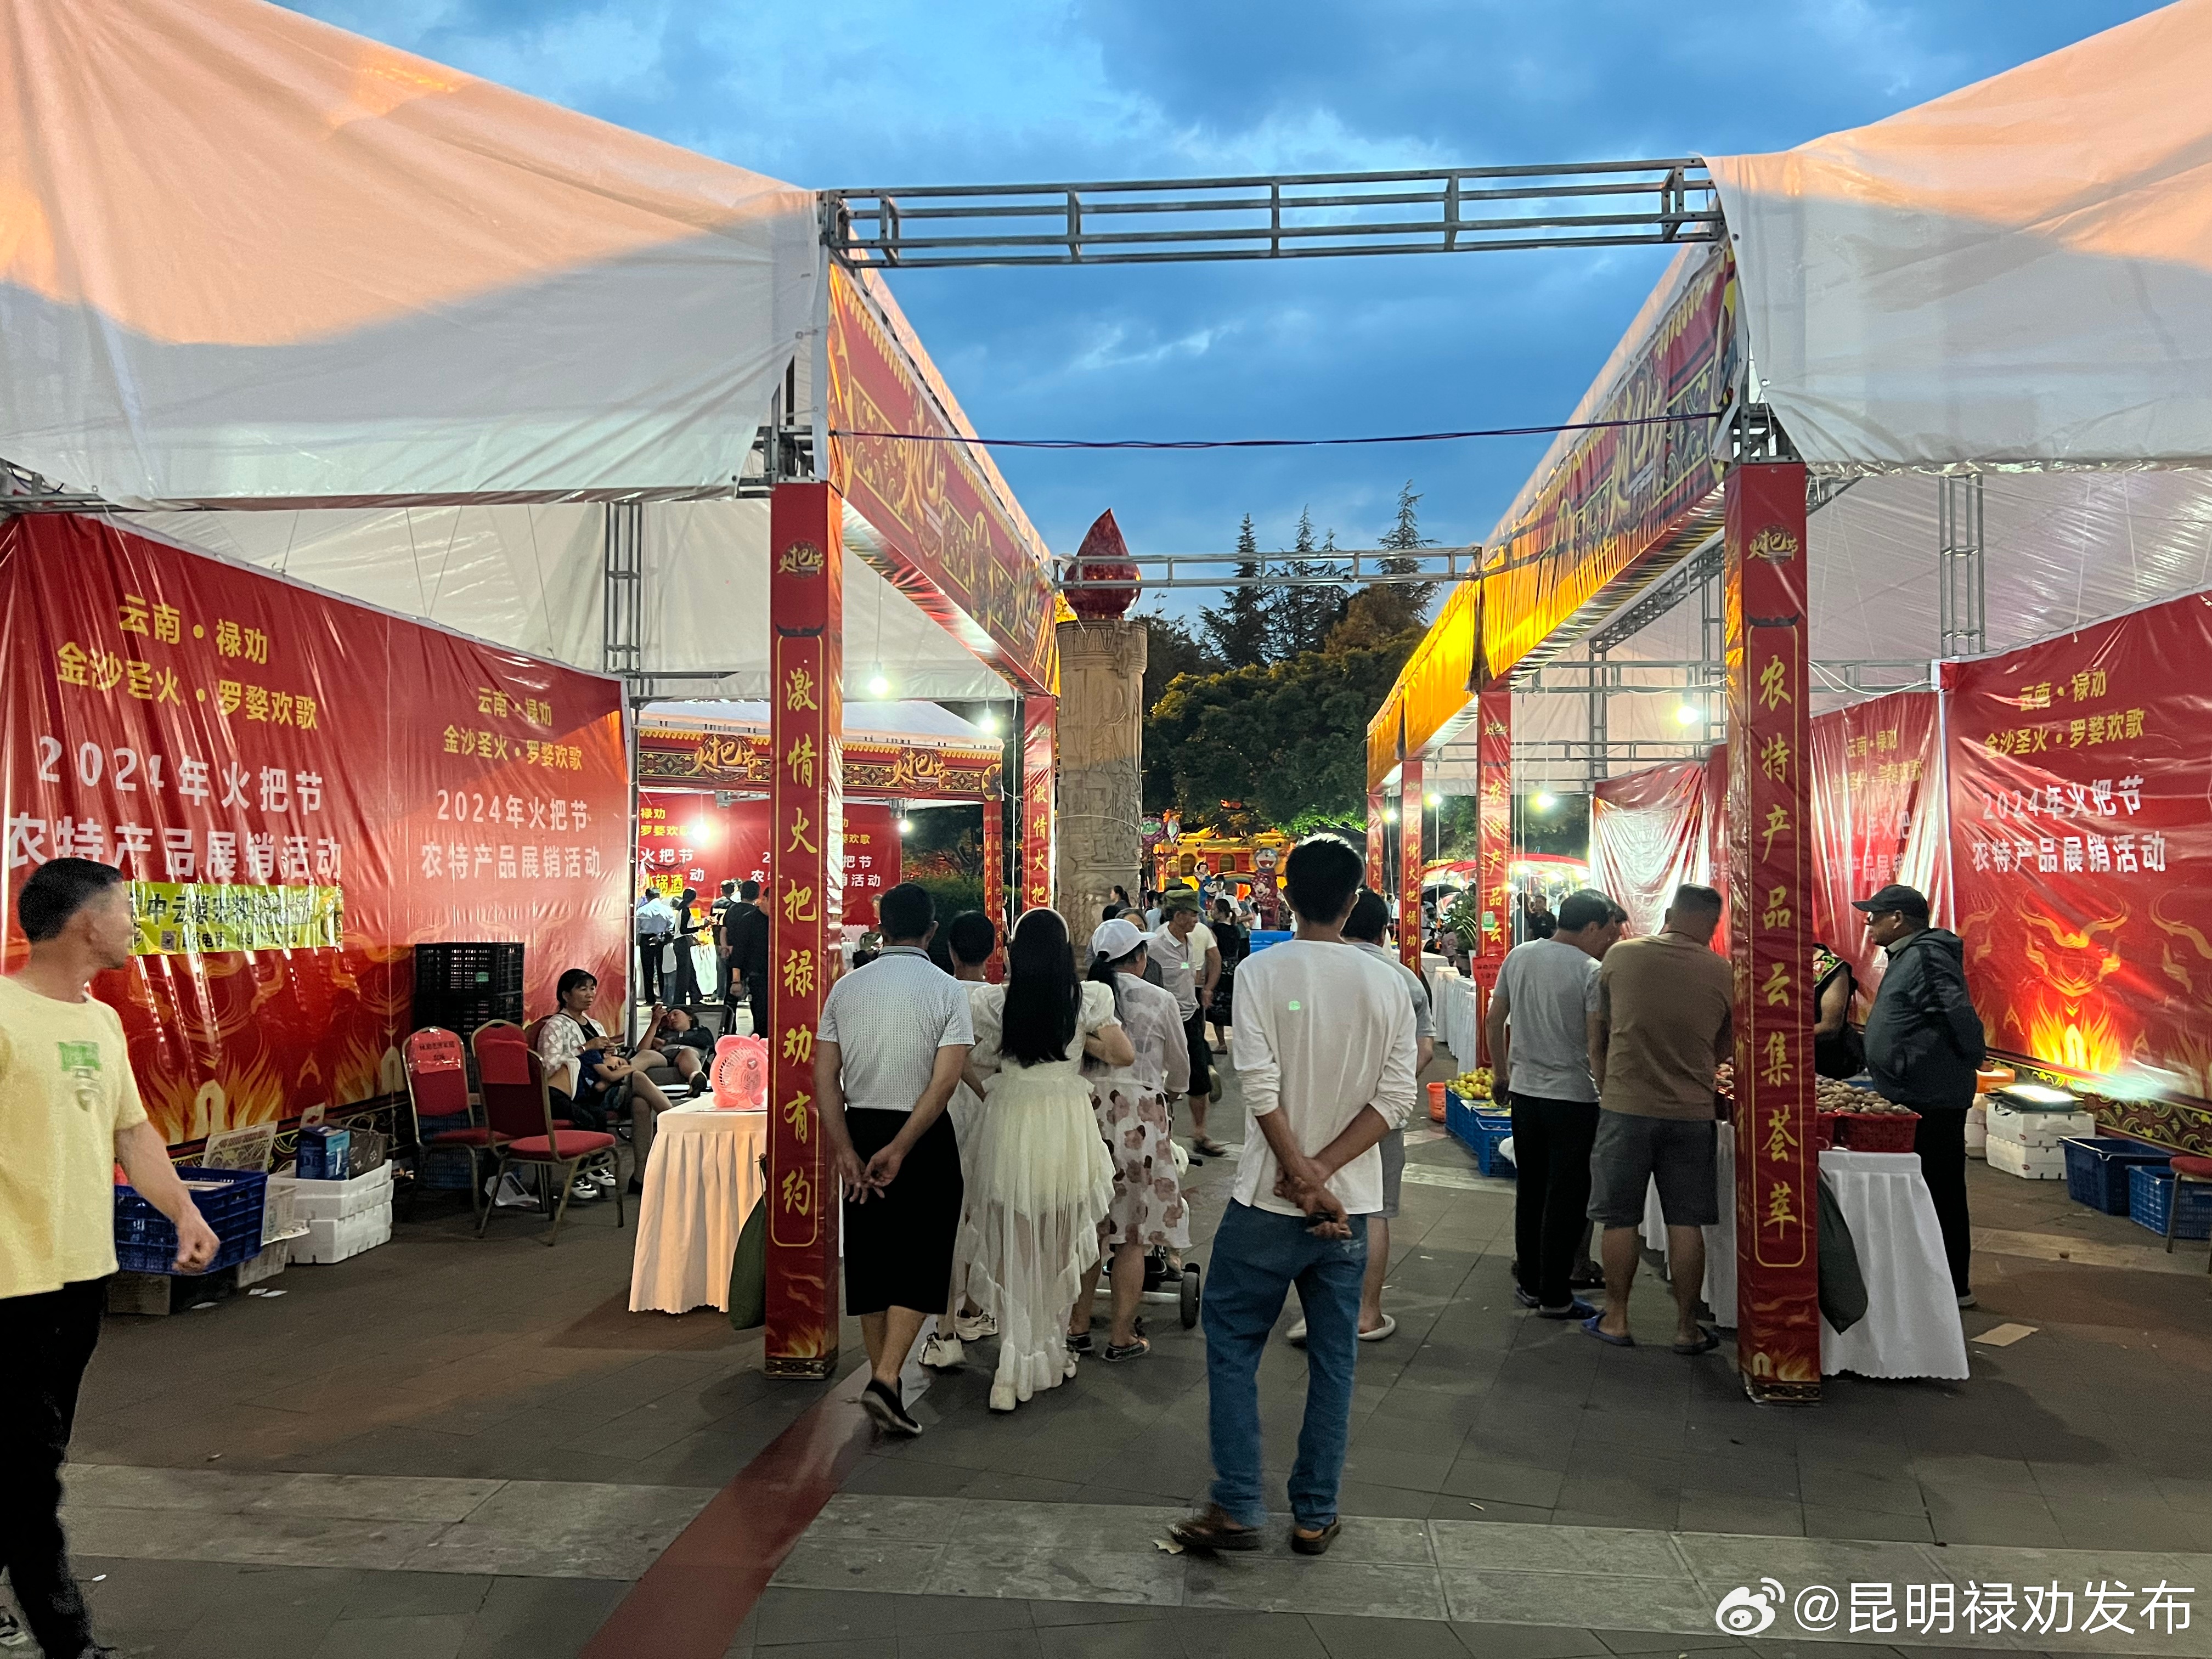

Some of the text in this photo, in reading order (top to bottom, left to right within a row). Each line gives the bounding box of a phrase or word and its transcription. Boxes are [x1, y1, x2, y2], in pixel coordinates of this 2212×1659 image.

[777, 546, 823, 574] 火把节
[1747, 530, 1798, 561] 火把节
[688, 736, 757, 778] 火把节
[890, 748, 946, 789] 火把节
[437, 789, 588, 832] 2024年火把节
[641, 808, 665, 819] 禄劝
[1982, 775, 2143, 820] 2024年火把节
[9, 812, 342, 879] 农特产品展销活动
[421, 841, 601, 879] 农特产品展销活动
[640, 848, 693, 863] 火把节
[1972, 831, 2166, 872] 农特产品展销活动
[636, 874, 684, 893] 小锅酒
[782, 668, 818, 1216] 激情火把禄劝有约
[1759, 655, 1798, 1240] 农特产品云集荟萃
